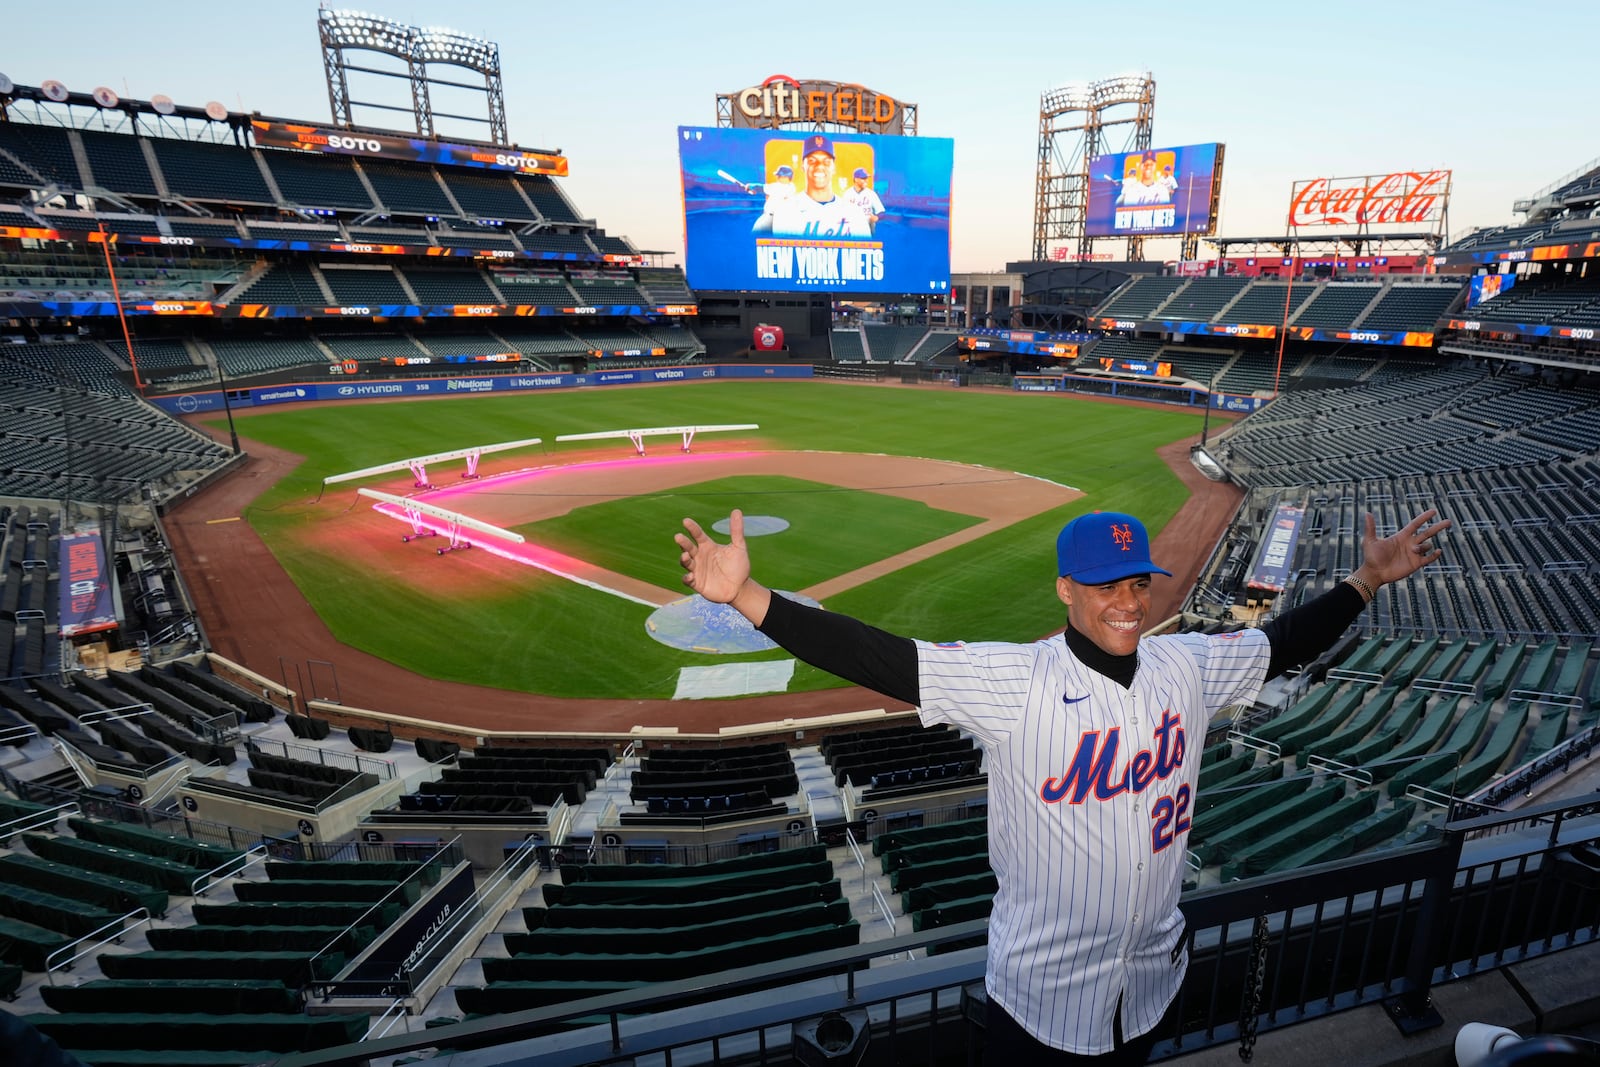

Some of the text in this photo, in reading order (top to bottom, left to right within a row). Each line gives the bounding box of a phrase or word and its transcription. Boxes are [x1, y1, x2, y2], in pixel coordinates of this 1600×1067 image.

[739, 79, 895, 123] citi FIELD
[327, 134, 381, 153] SOTO
[496, 154, 539, 169] SOTO
[160, 236, 194, 246] SOTO
[345, 244, 372, 252] SOTO
[492, 250, 515, 258] SOTO
[1508, 250, 1526, 261] SOTO
[756, 246, 884, 281] NEW YORK METS
[152, 304, 184, 312] SOTO
[340, 307, 370, 315] SOTO
[1116, 321, 1136, 329] SOTO
[1225, 326, 1249, 335] SOTO
[1570, 328, 1594, 339] SOTO
[1350, 333, 1380, 341] SOTO
[654, 370, 684, 379] verizon
[457, 379, 494, 389] National
[518, 376, 561, 386] Northwell
[357, 384, 403, 395] HYUNDAI
[260, 391, 297, 401] smartwater
[1227, 400, 1250, 410] Corona
[1040, 708, 1187, 805] Mets
[1151, 783, 1192, 853] 22
